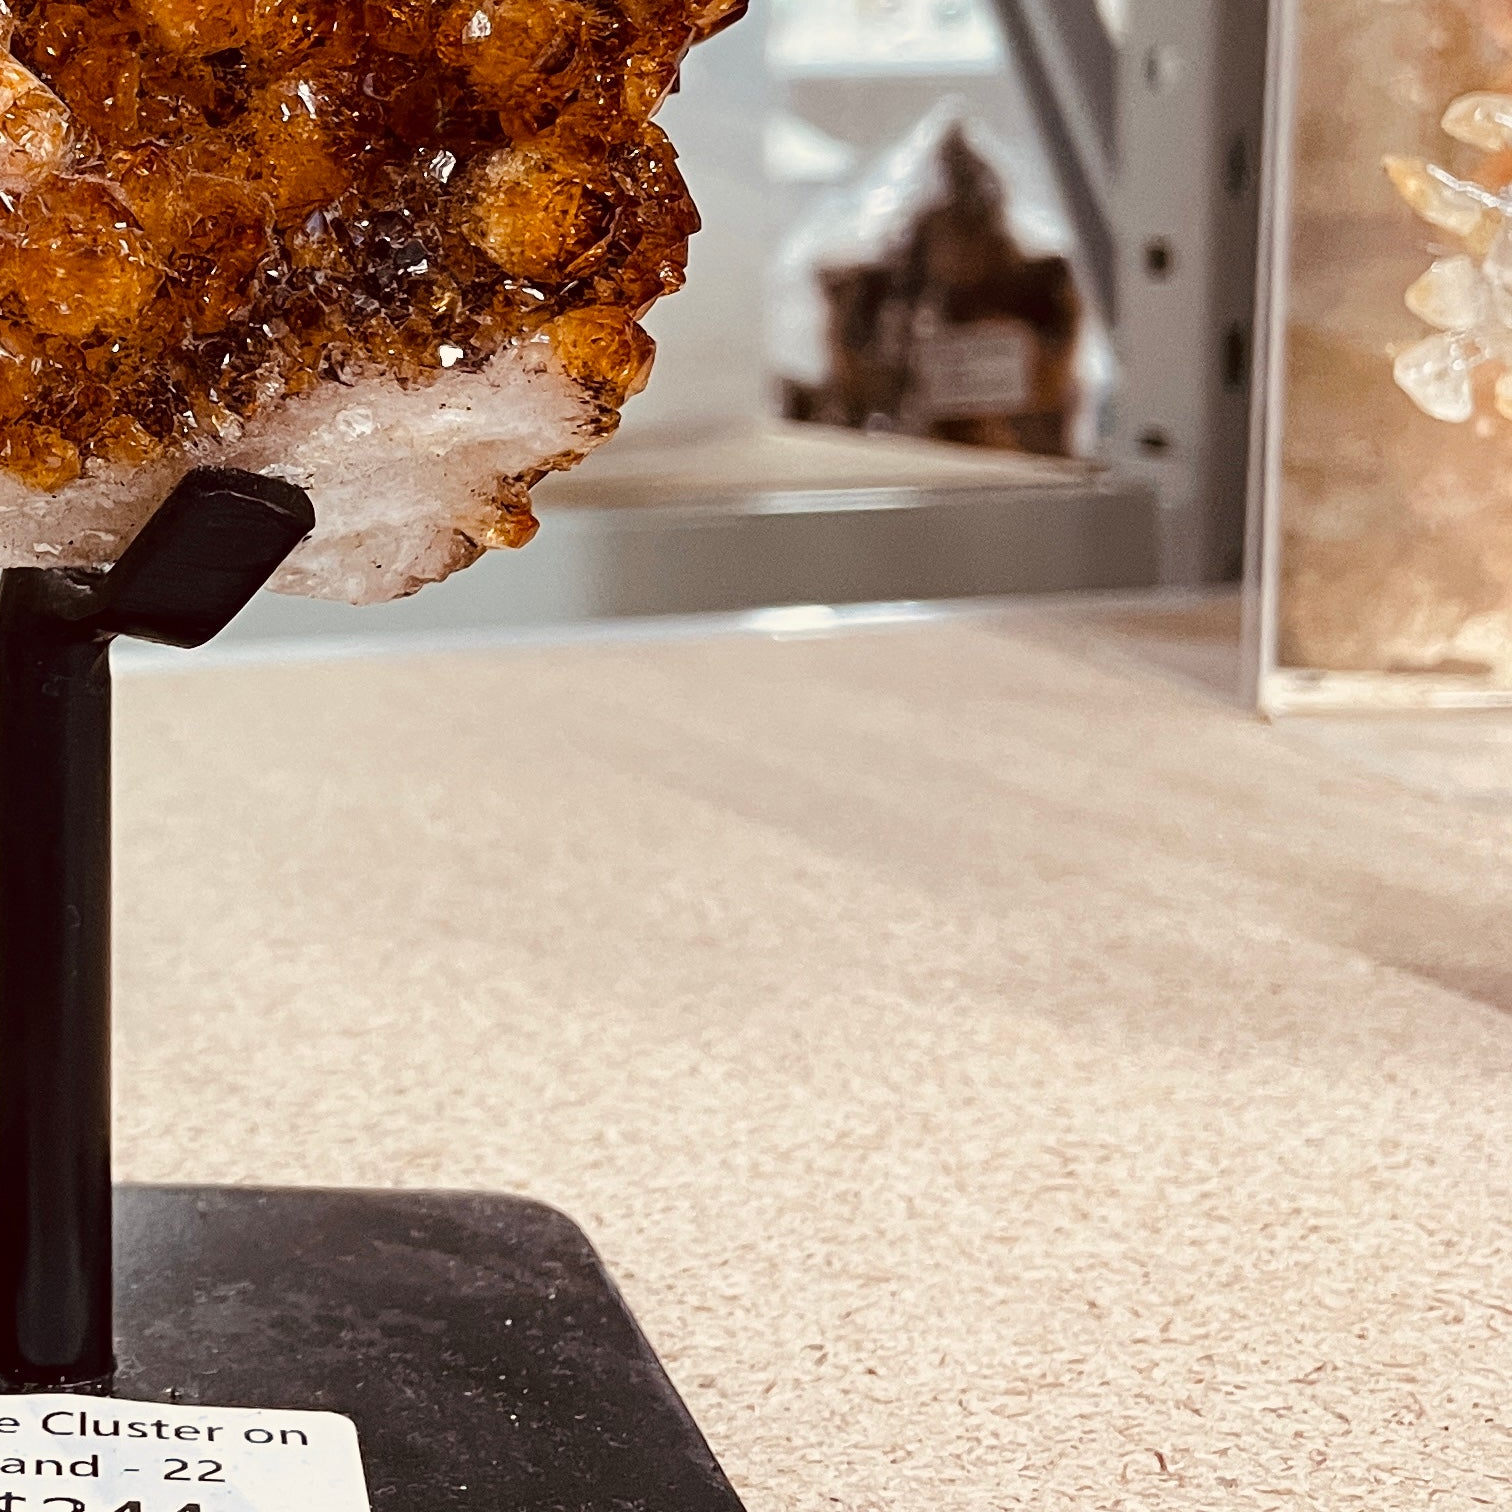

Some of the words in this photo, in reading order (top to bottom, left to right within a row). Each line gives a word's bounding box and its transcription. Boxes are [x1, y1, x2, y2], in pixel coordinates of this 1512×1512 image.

[41, 1410, 223, 1443] Cluster
[244, 1427, 309, 1446] on
[163, 1457, 226, 1483] 22
